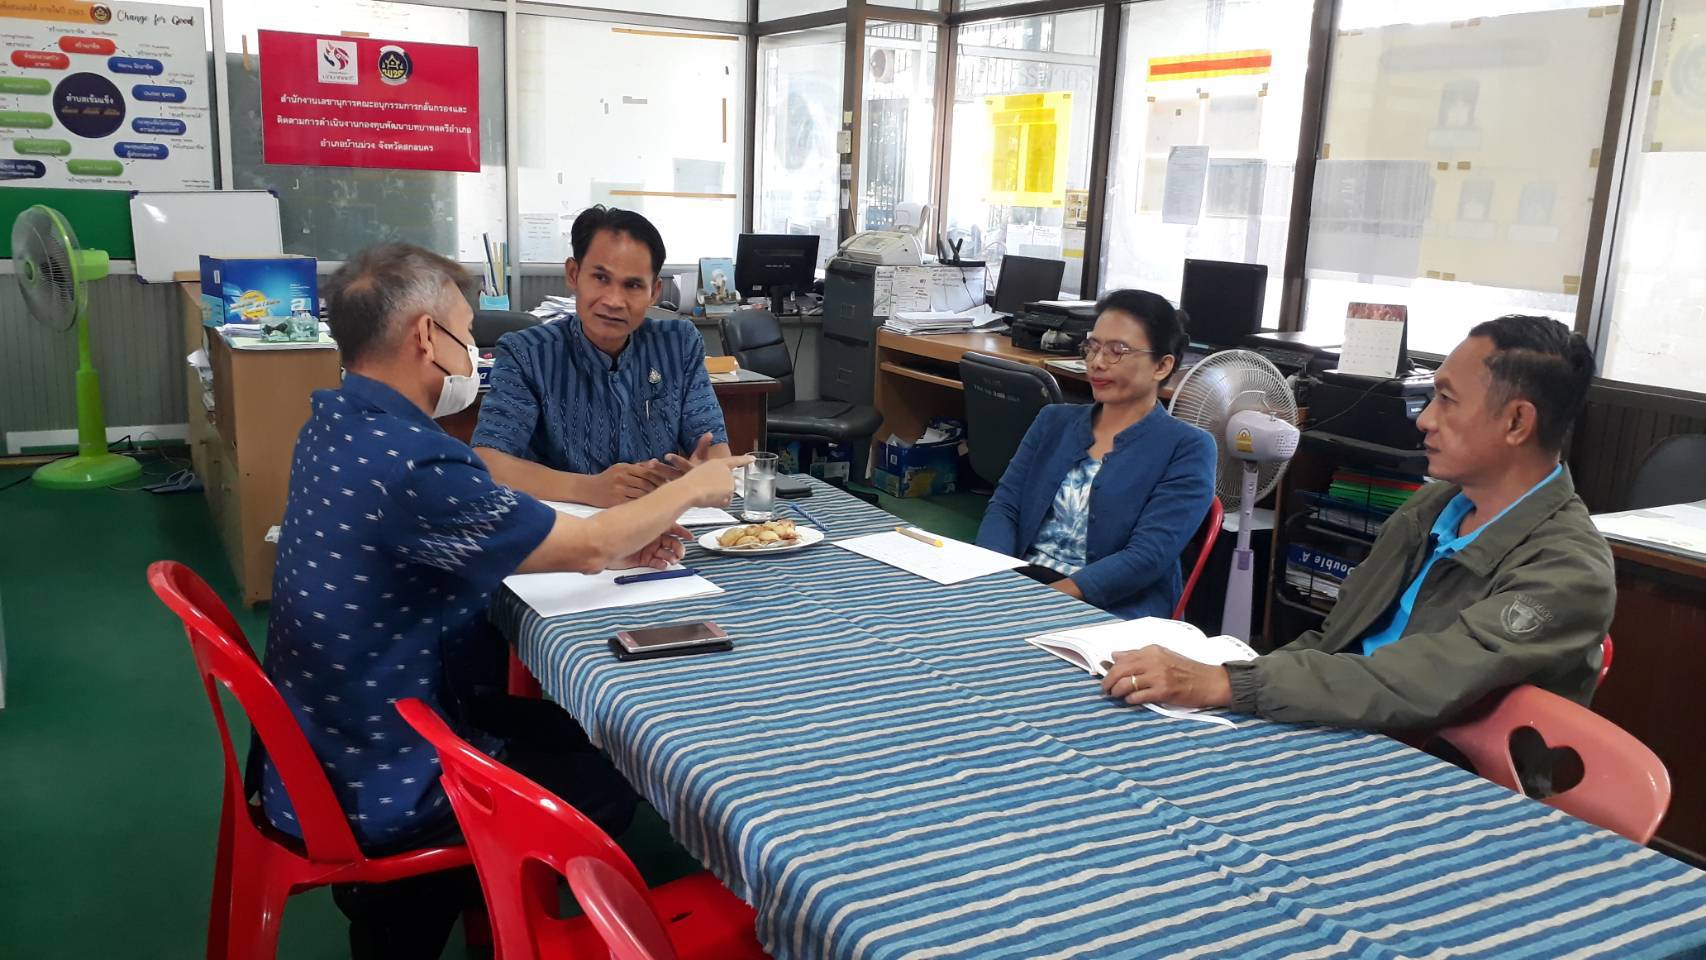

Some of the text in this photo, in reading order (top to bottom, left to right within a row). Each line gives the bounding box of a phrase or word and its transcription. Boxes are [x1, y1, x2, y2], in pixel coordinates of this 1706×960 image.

[117, 9, 195, 26] Change for Good
[280, 93, 467, 114] สำนักงานเลขานุการคณะอนุกรรมการกลั่นกรองและ
[320, 138, 434, 152] อำเภอบ้านม่วง จังหวัดสกลนคร
[1302, 551, 1311, 562] A
